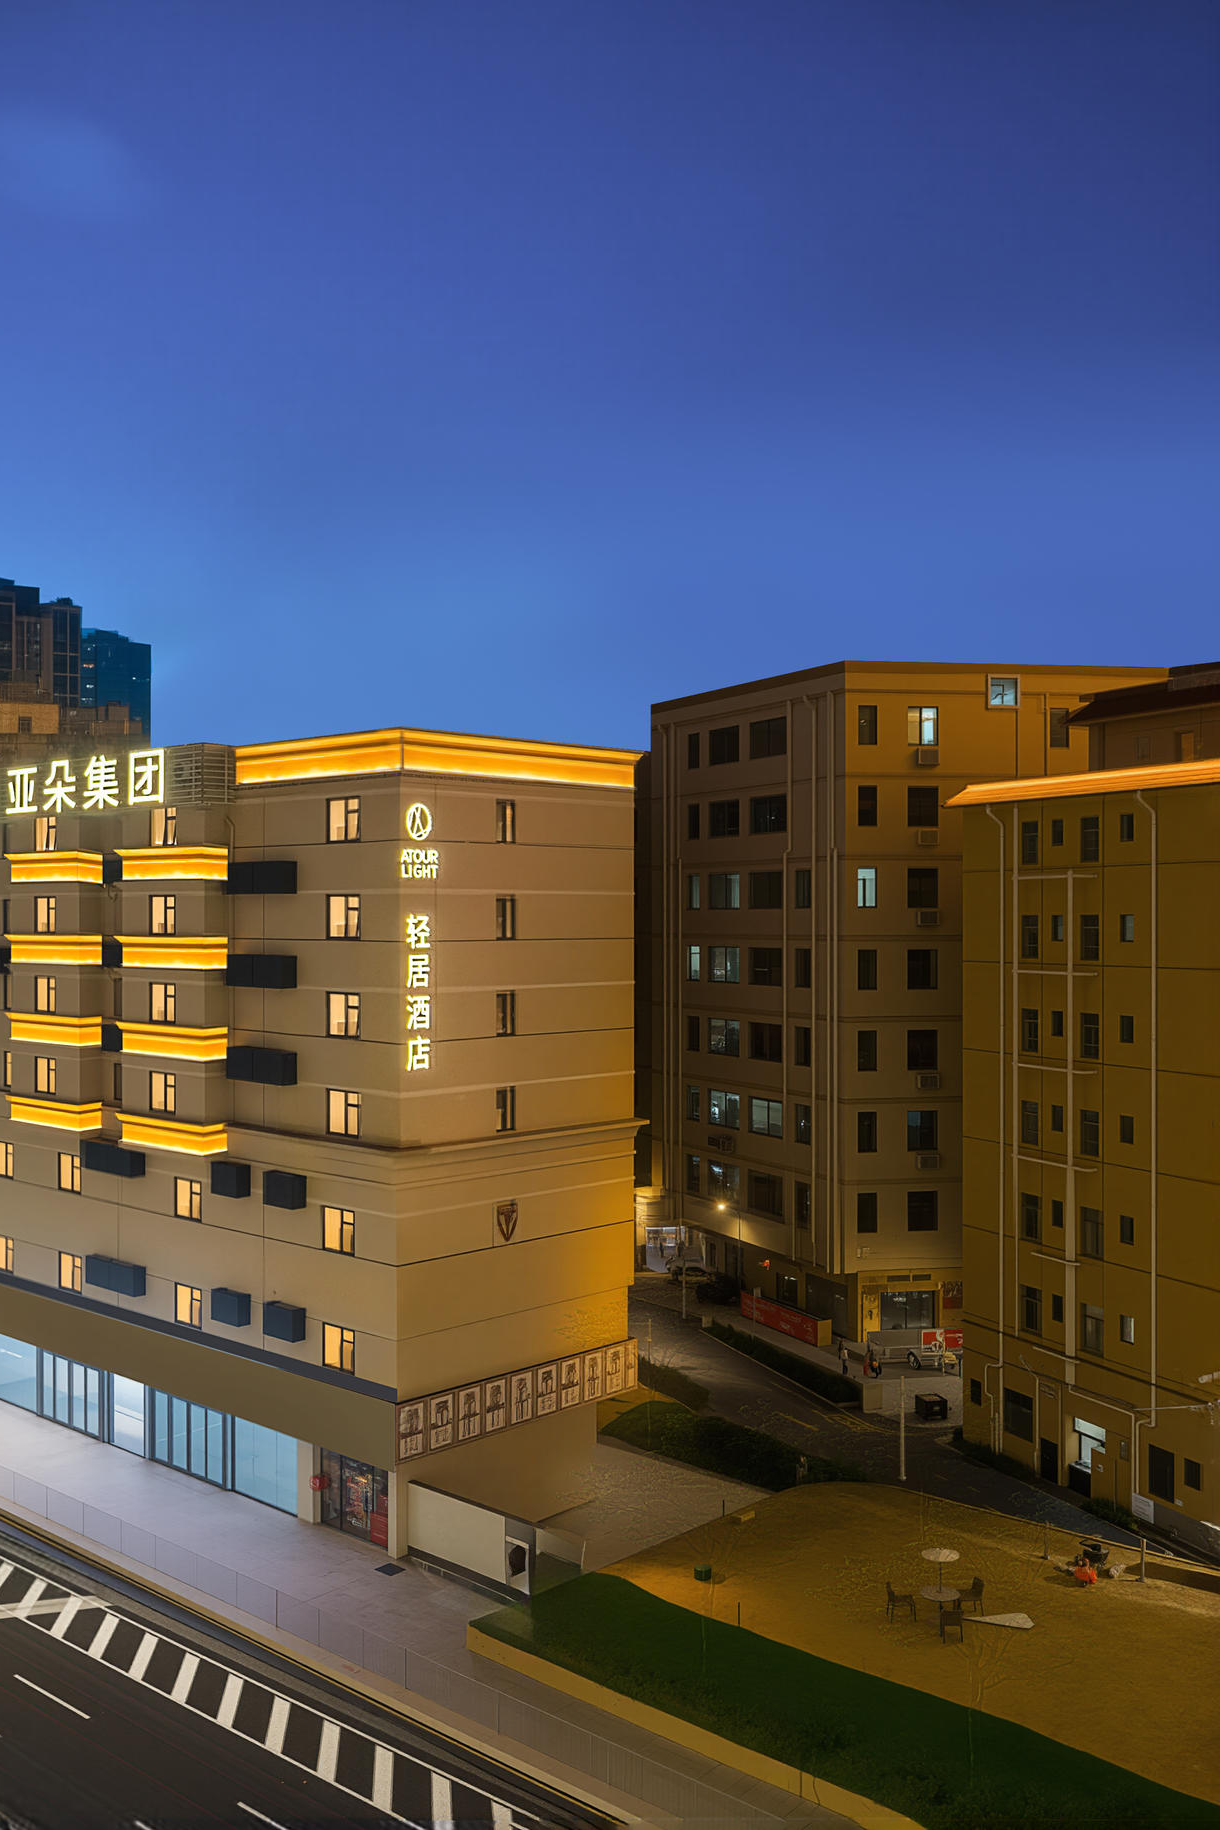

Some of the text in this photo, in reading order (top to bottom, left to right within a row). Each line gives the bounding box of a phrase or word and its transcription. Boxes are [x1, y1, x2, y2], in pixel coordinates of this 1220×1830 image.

[5, 748, 165, 815] 亚朵集团
[401, 848, 439, 864] ATOUR
[401, 864, 439, 880] LIGHT
[405, 914, 431, 1072] 轻居酒店
